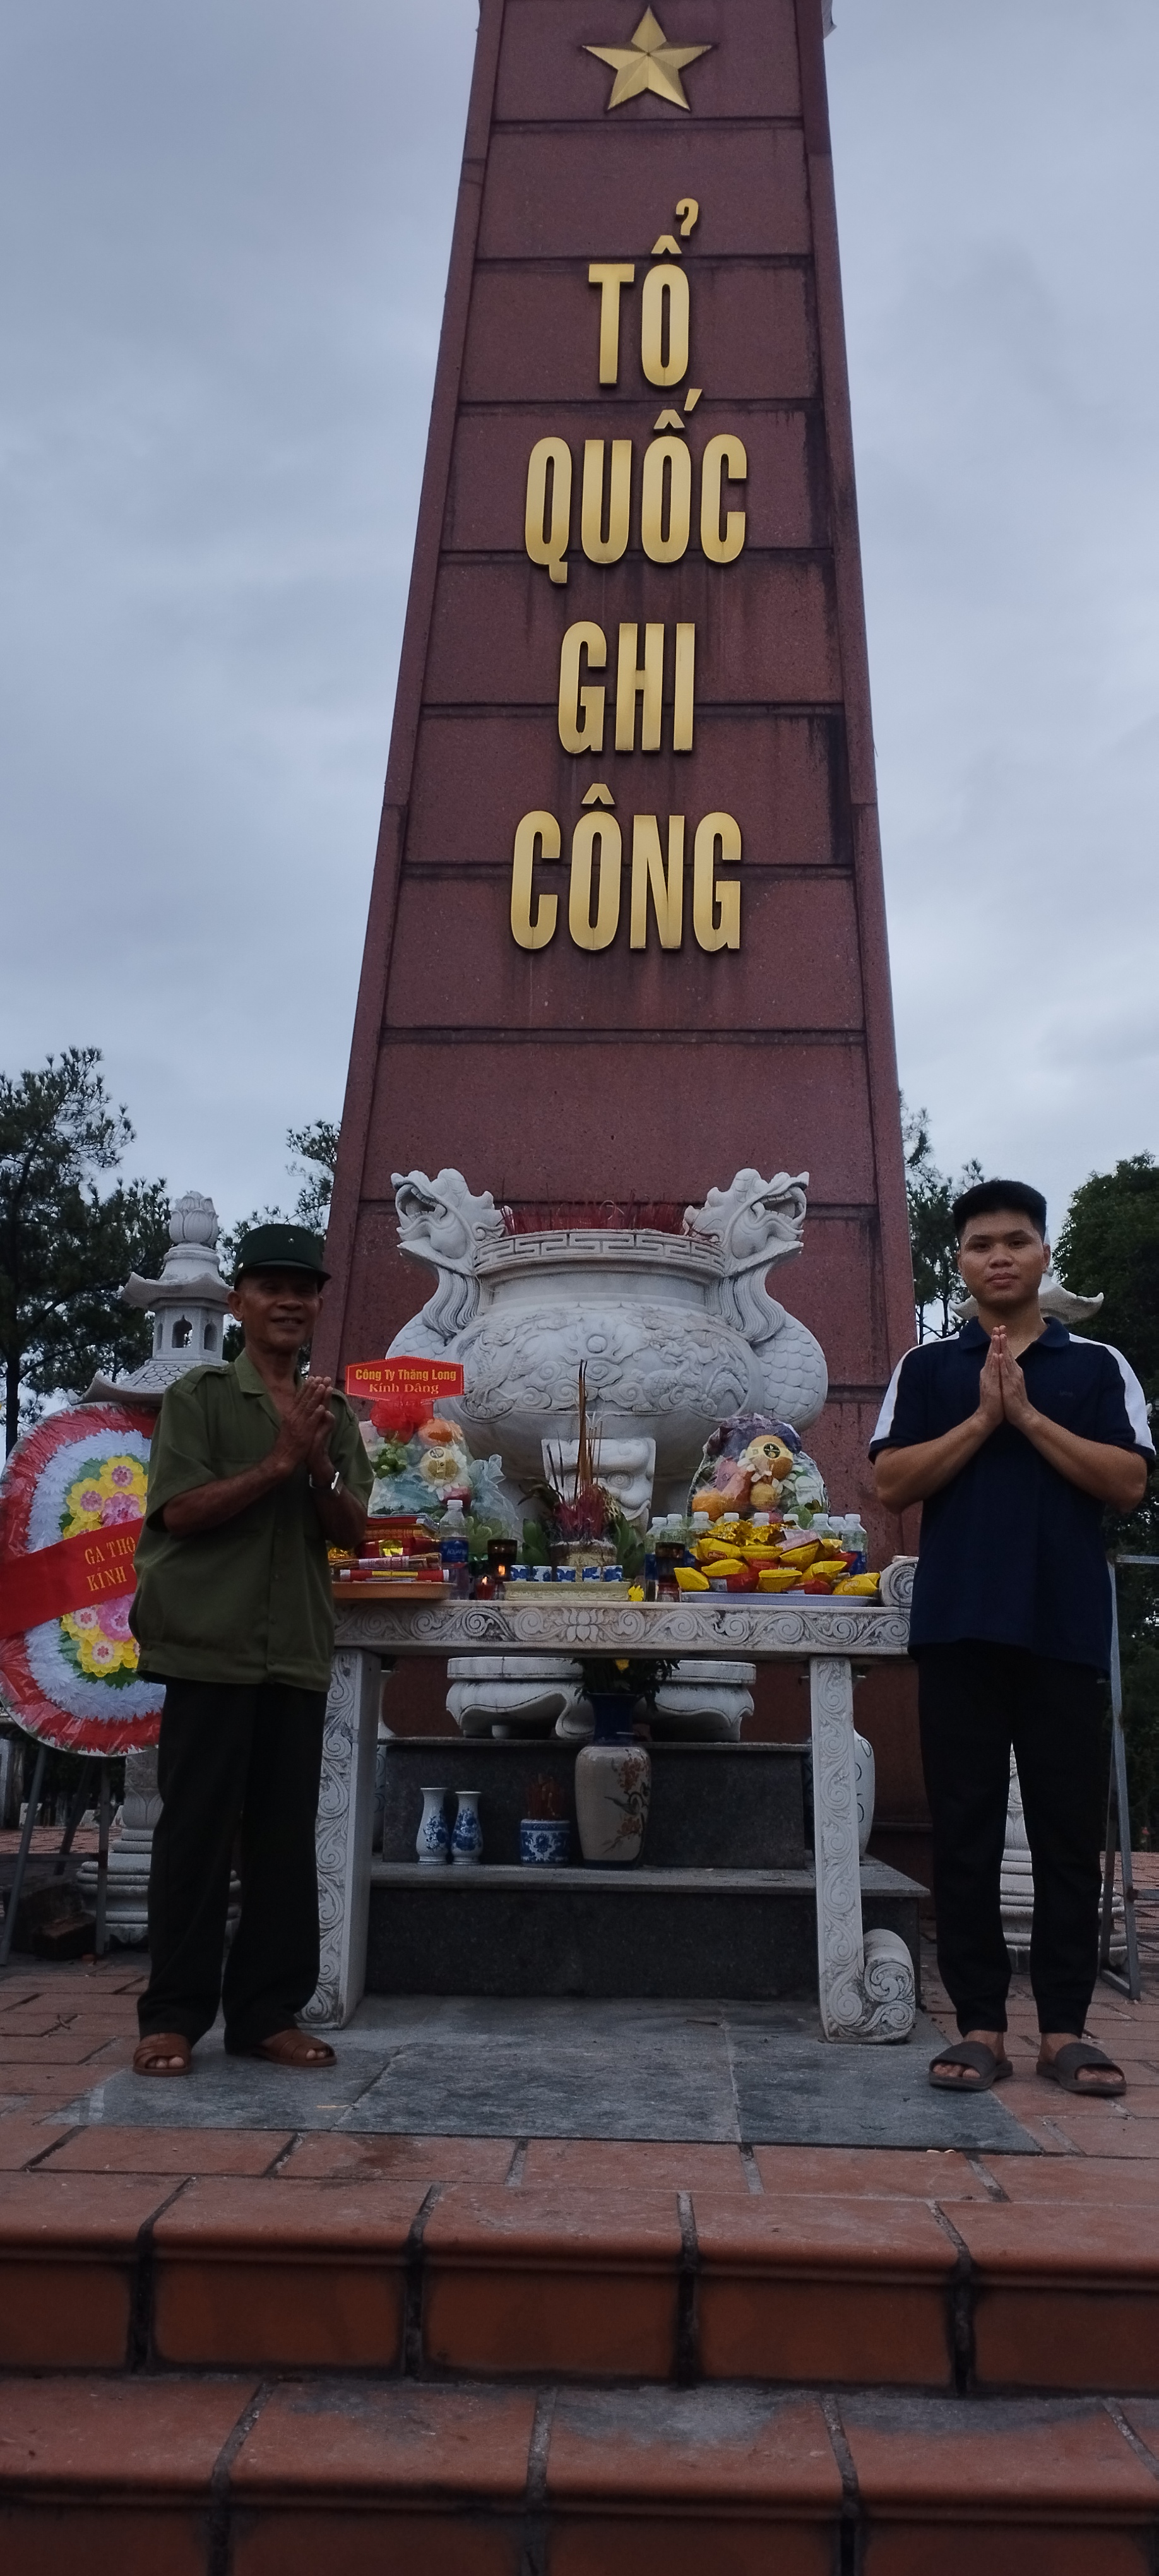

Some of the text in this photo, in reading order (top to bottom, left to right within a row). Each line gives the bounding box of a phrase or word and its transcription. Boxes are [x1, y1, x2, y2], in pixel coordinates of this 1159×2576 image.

[589, 198, 699, 386] TỔ
[525, 388, 747, 583] QUỐC
[558, 621, 695, 753] GHI
[511, 783, 742, 951] CÔNG
[355, 1369, 456, 1381] Công Ty Thăng Long
[369, 1383, 439, 1394] Kính Dâng
[85, 1546, 105, 1565] GA
[86, 1566, 128, 1591] KÍNH
